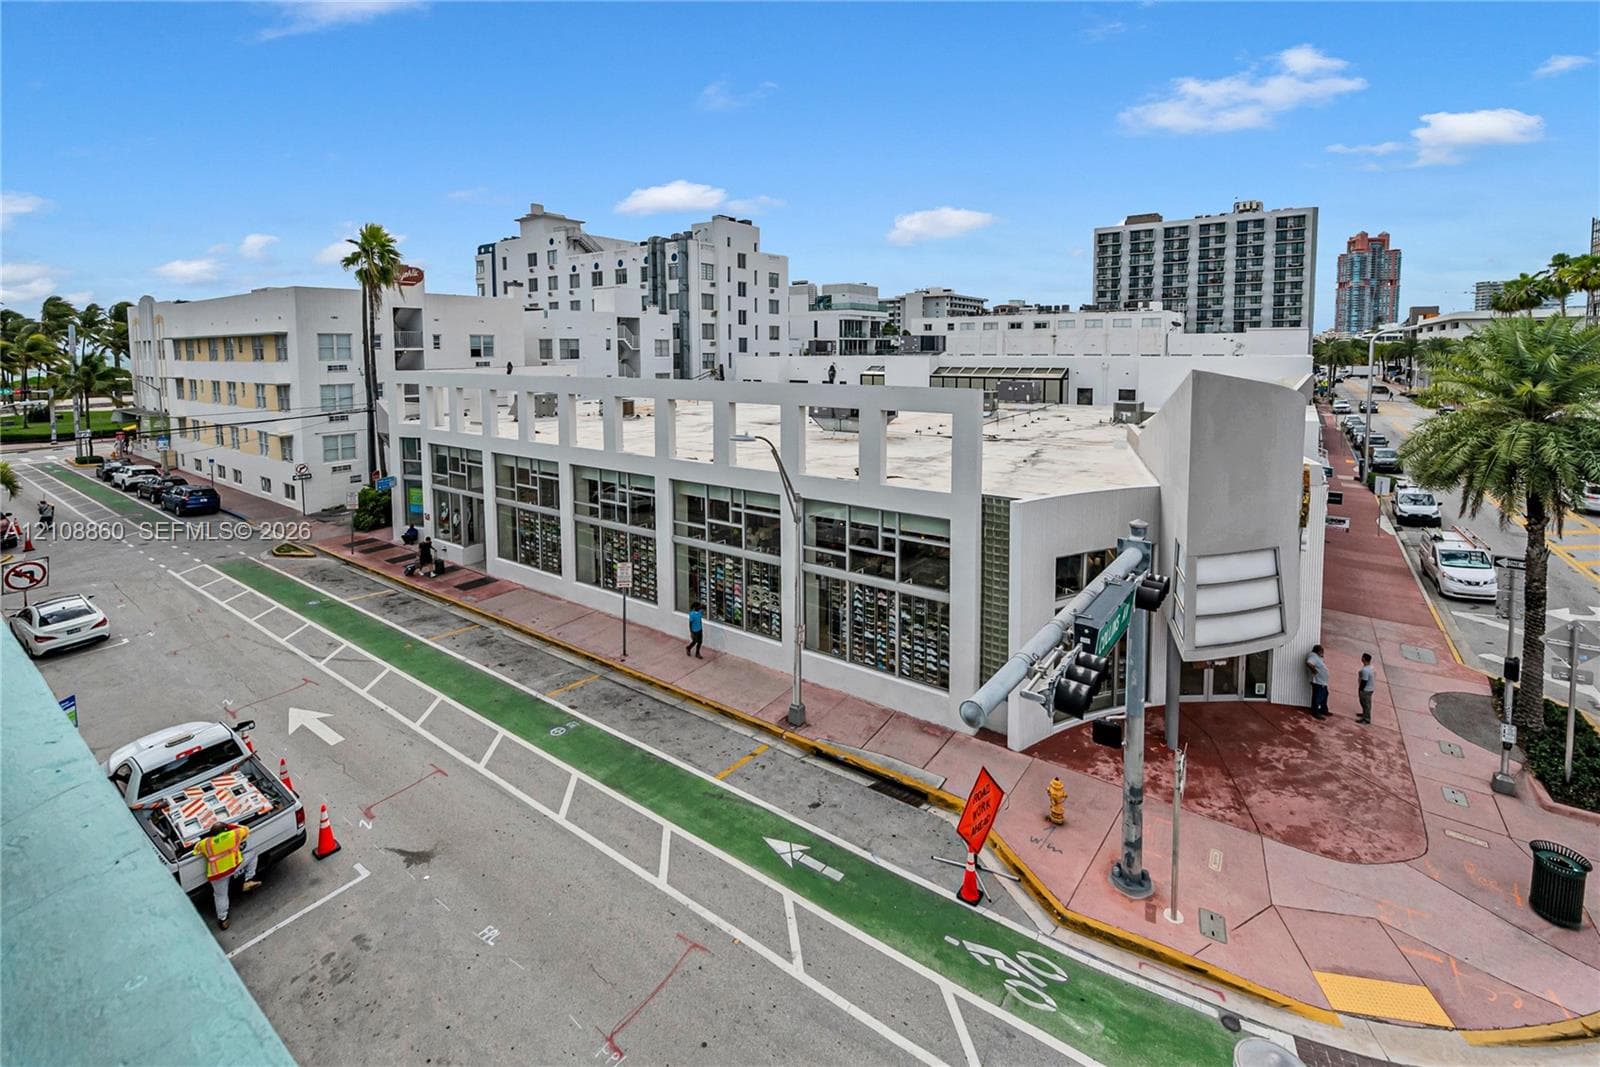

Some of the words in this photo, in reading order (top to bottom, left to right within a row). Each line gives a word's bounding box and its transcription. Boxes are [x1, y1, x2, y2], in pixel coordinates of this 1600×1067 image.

[1098, 614, 1120, 654] COLLINS
[972, 783, 990, 805] ROAD
[972, 801, 990, 821] WORK
[971, 814, 990, 836] AHEAD
